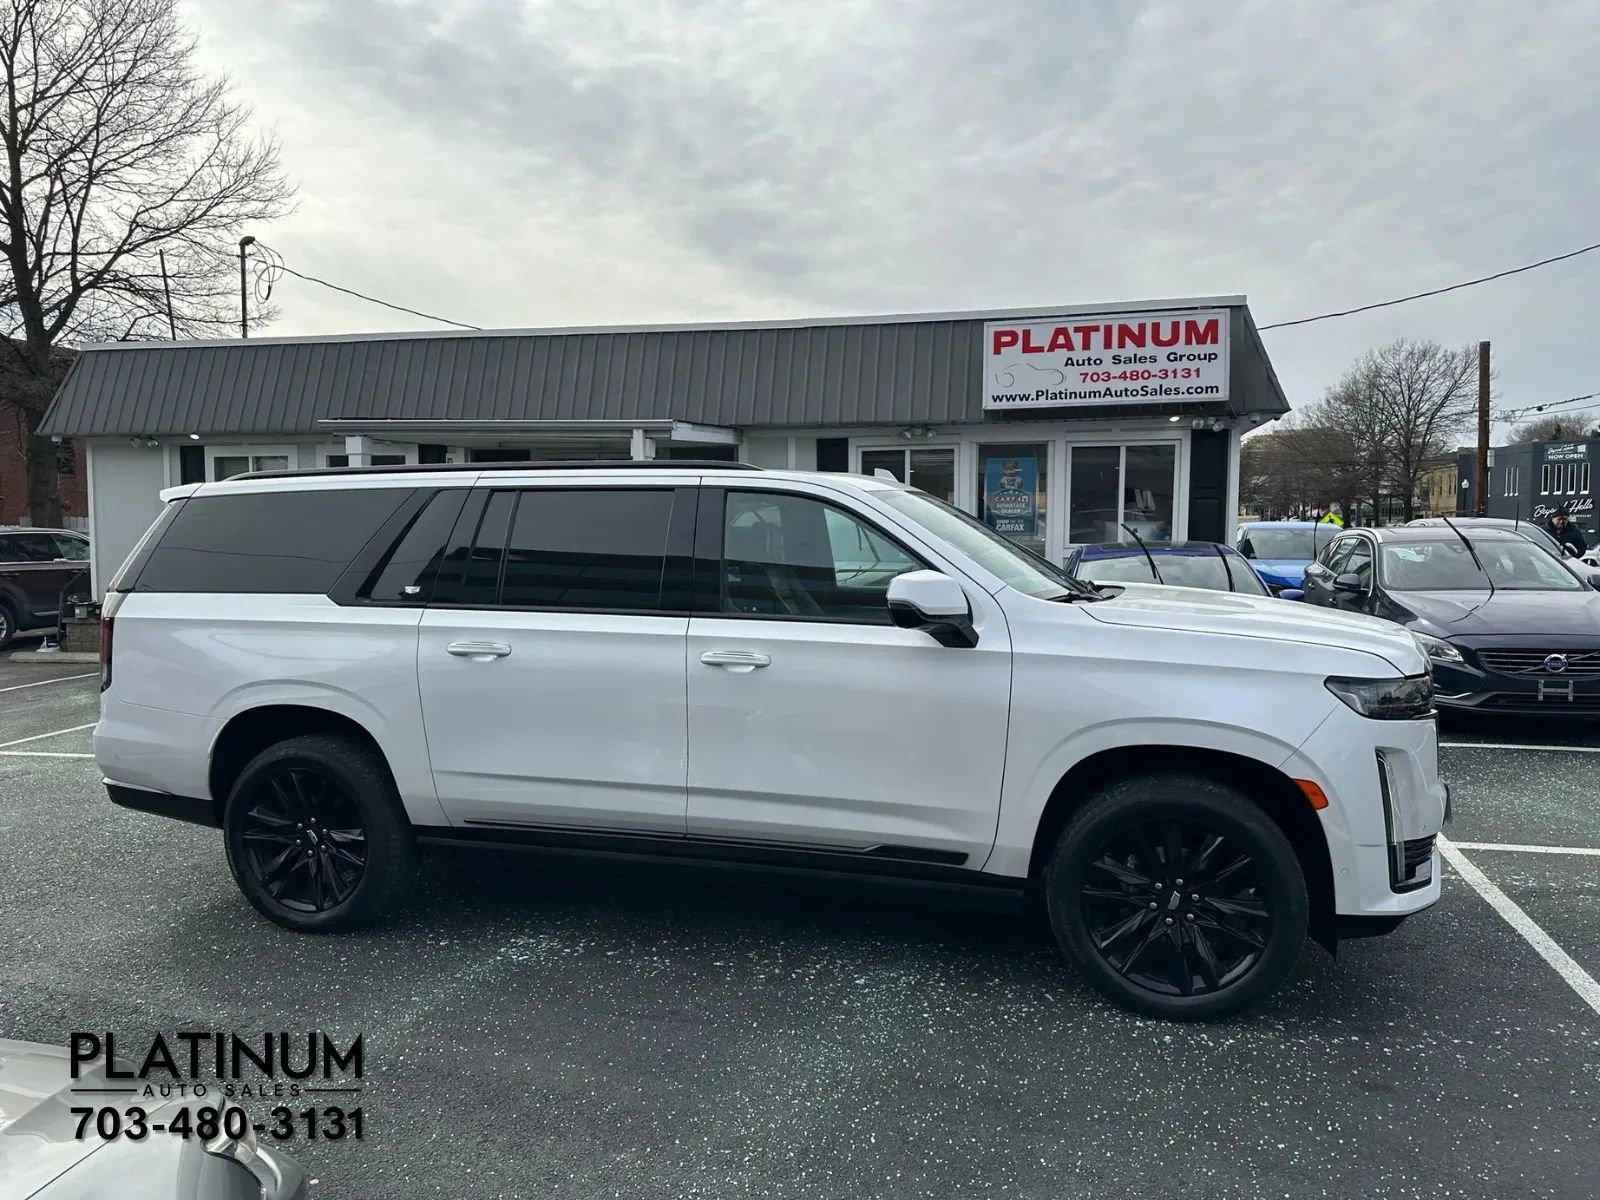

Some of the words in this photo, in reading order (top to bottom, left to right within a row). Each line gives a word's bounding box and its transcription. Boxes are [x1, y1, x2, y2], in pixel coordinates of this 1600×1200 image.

[992, 318, 1220, 355] PLATINUM
[1064, 356, 1103, 368] Auto
[1111, 354, 1158, 366] Sales
[1166, 351, 1219, 364] Group
[1079, 367, 1202, 384] 703-480-3131
[991, 384, 1220, 403] www.PlatinumAutoSales.com
[1569, 498, 1593, 513] Hello
[995, 523, 1025, 532] CARFAX
